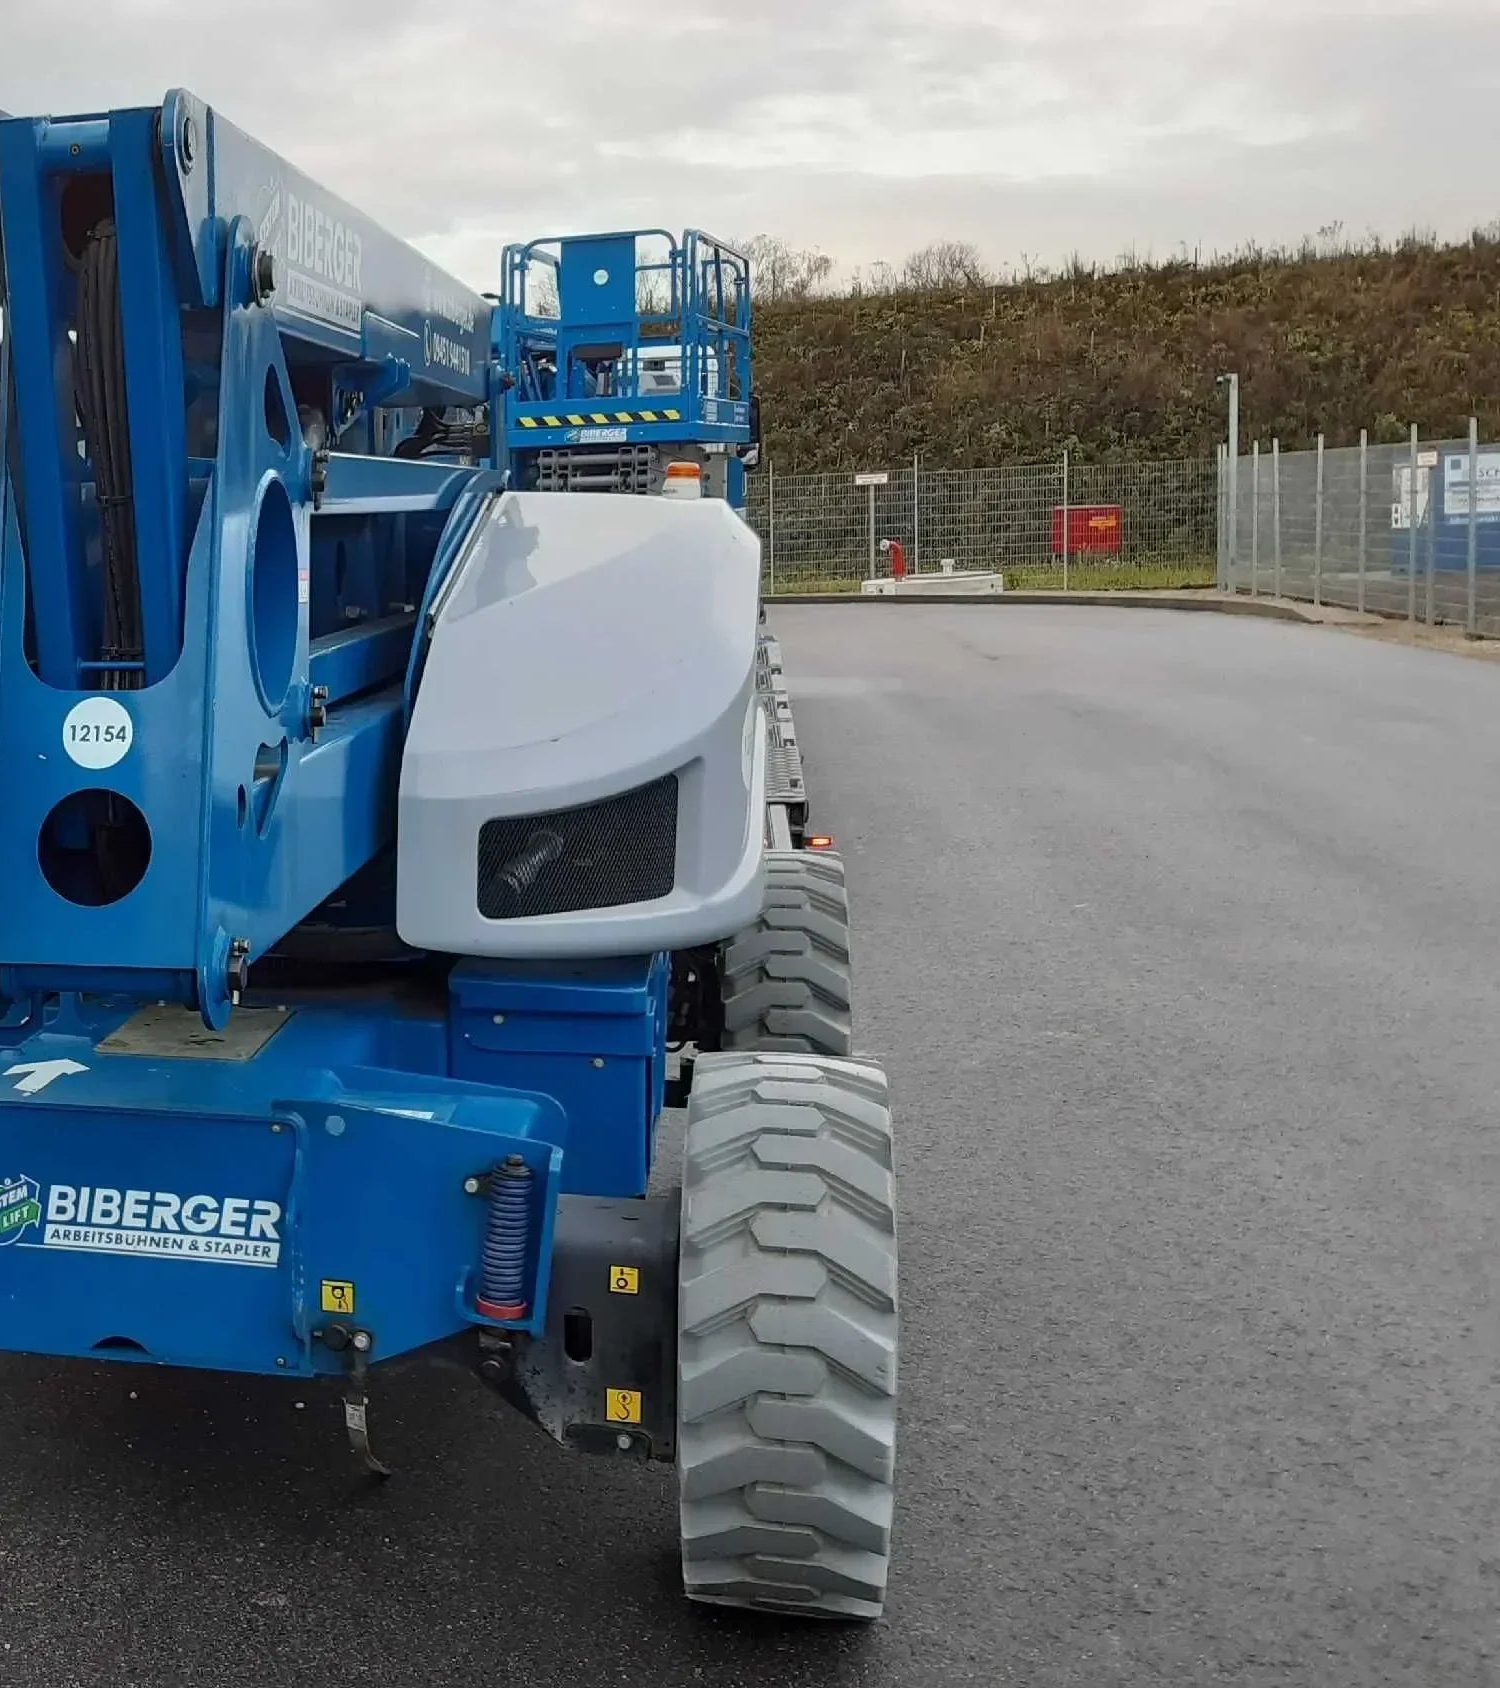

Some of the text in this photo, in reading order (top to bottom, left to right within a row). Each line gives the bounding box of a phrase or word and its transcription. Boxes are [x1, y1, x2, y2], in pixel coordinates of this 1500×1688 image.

[287, 193, 362, 293] BIBERGER
[70, 724, 127, 743] 12154
[3, 1206, 30, 1228] LIFT
[46, 1184, 281, 1240] BIBERGER
[50, 1229, 273, 1259] ARBEITSBÜHNEN & STAPLER
